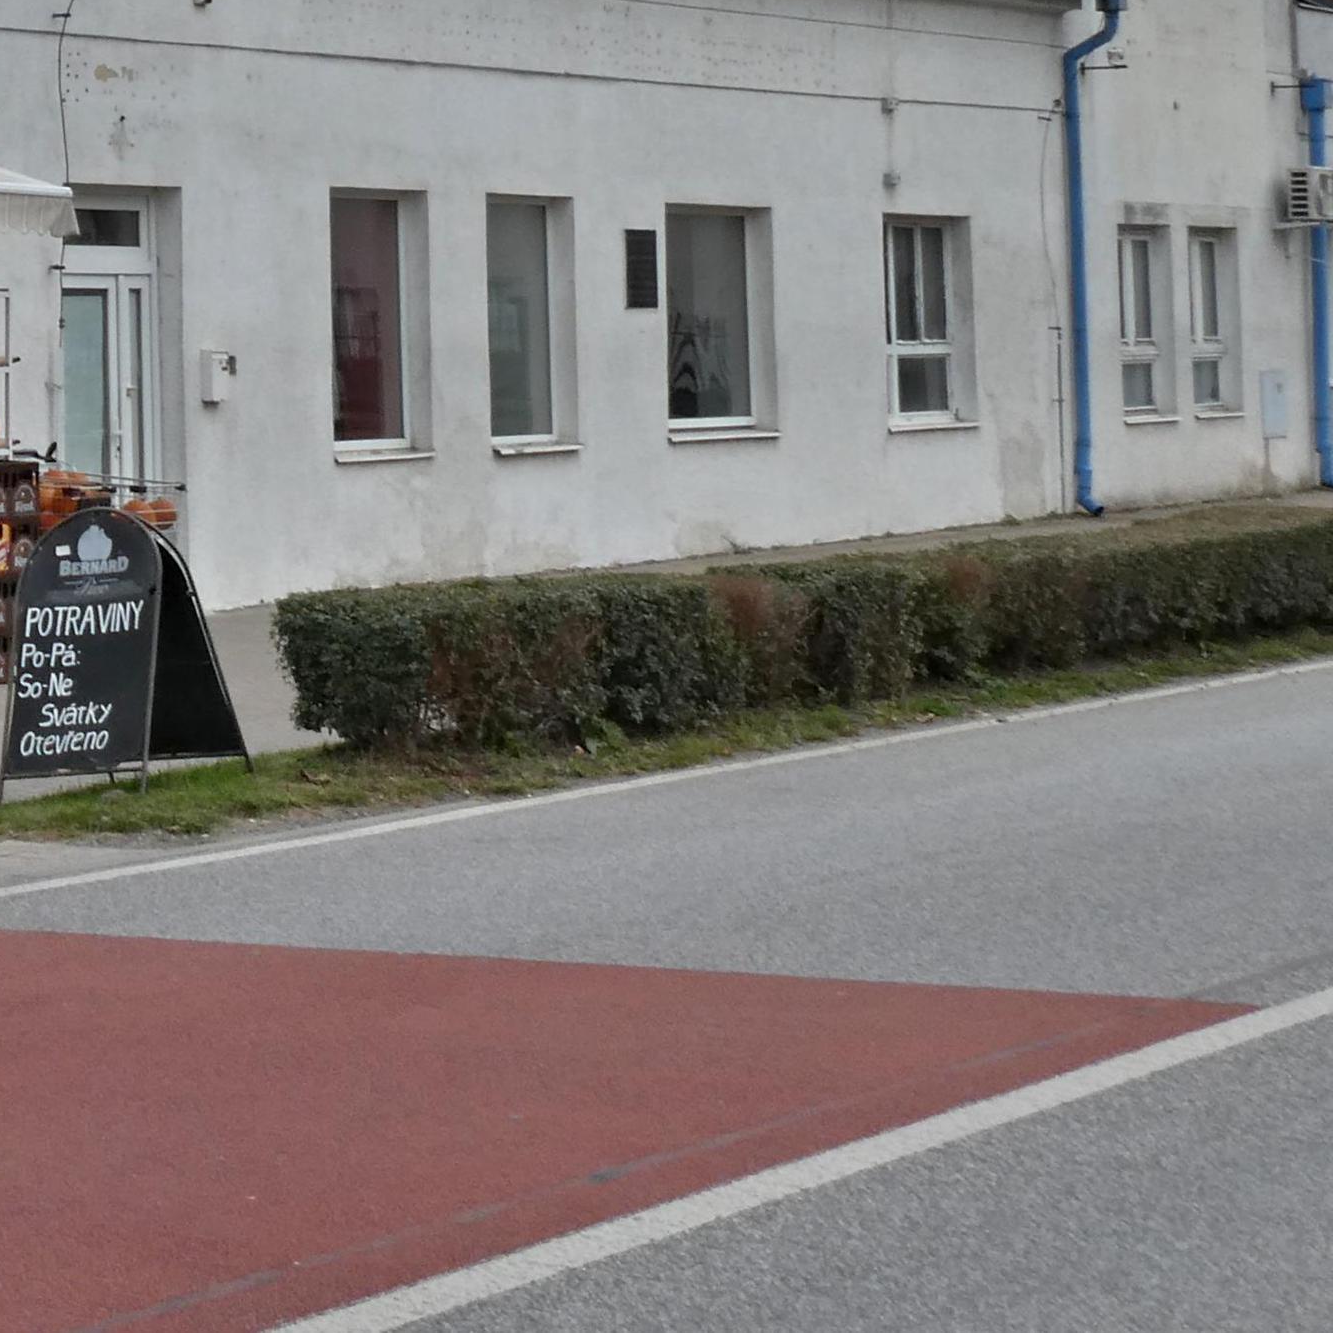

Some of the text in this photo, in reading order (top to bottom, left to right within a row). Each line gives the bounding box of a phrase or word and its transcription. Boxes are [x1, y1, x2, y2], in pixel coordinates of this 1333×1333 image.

[59, 555, 129, 576] BERNARD
[24, 599, 144, 638] POTRAVINY
[20, 641, 82, 668] Po-Pá:
[17, 673, 73, 698] So-Ne
[38, 702, 113, 728] Svátky
[19, 729, 110, 757] Otevřeno
